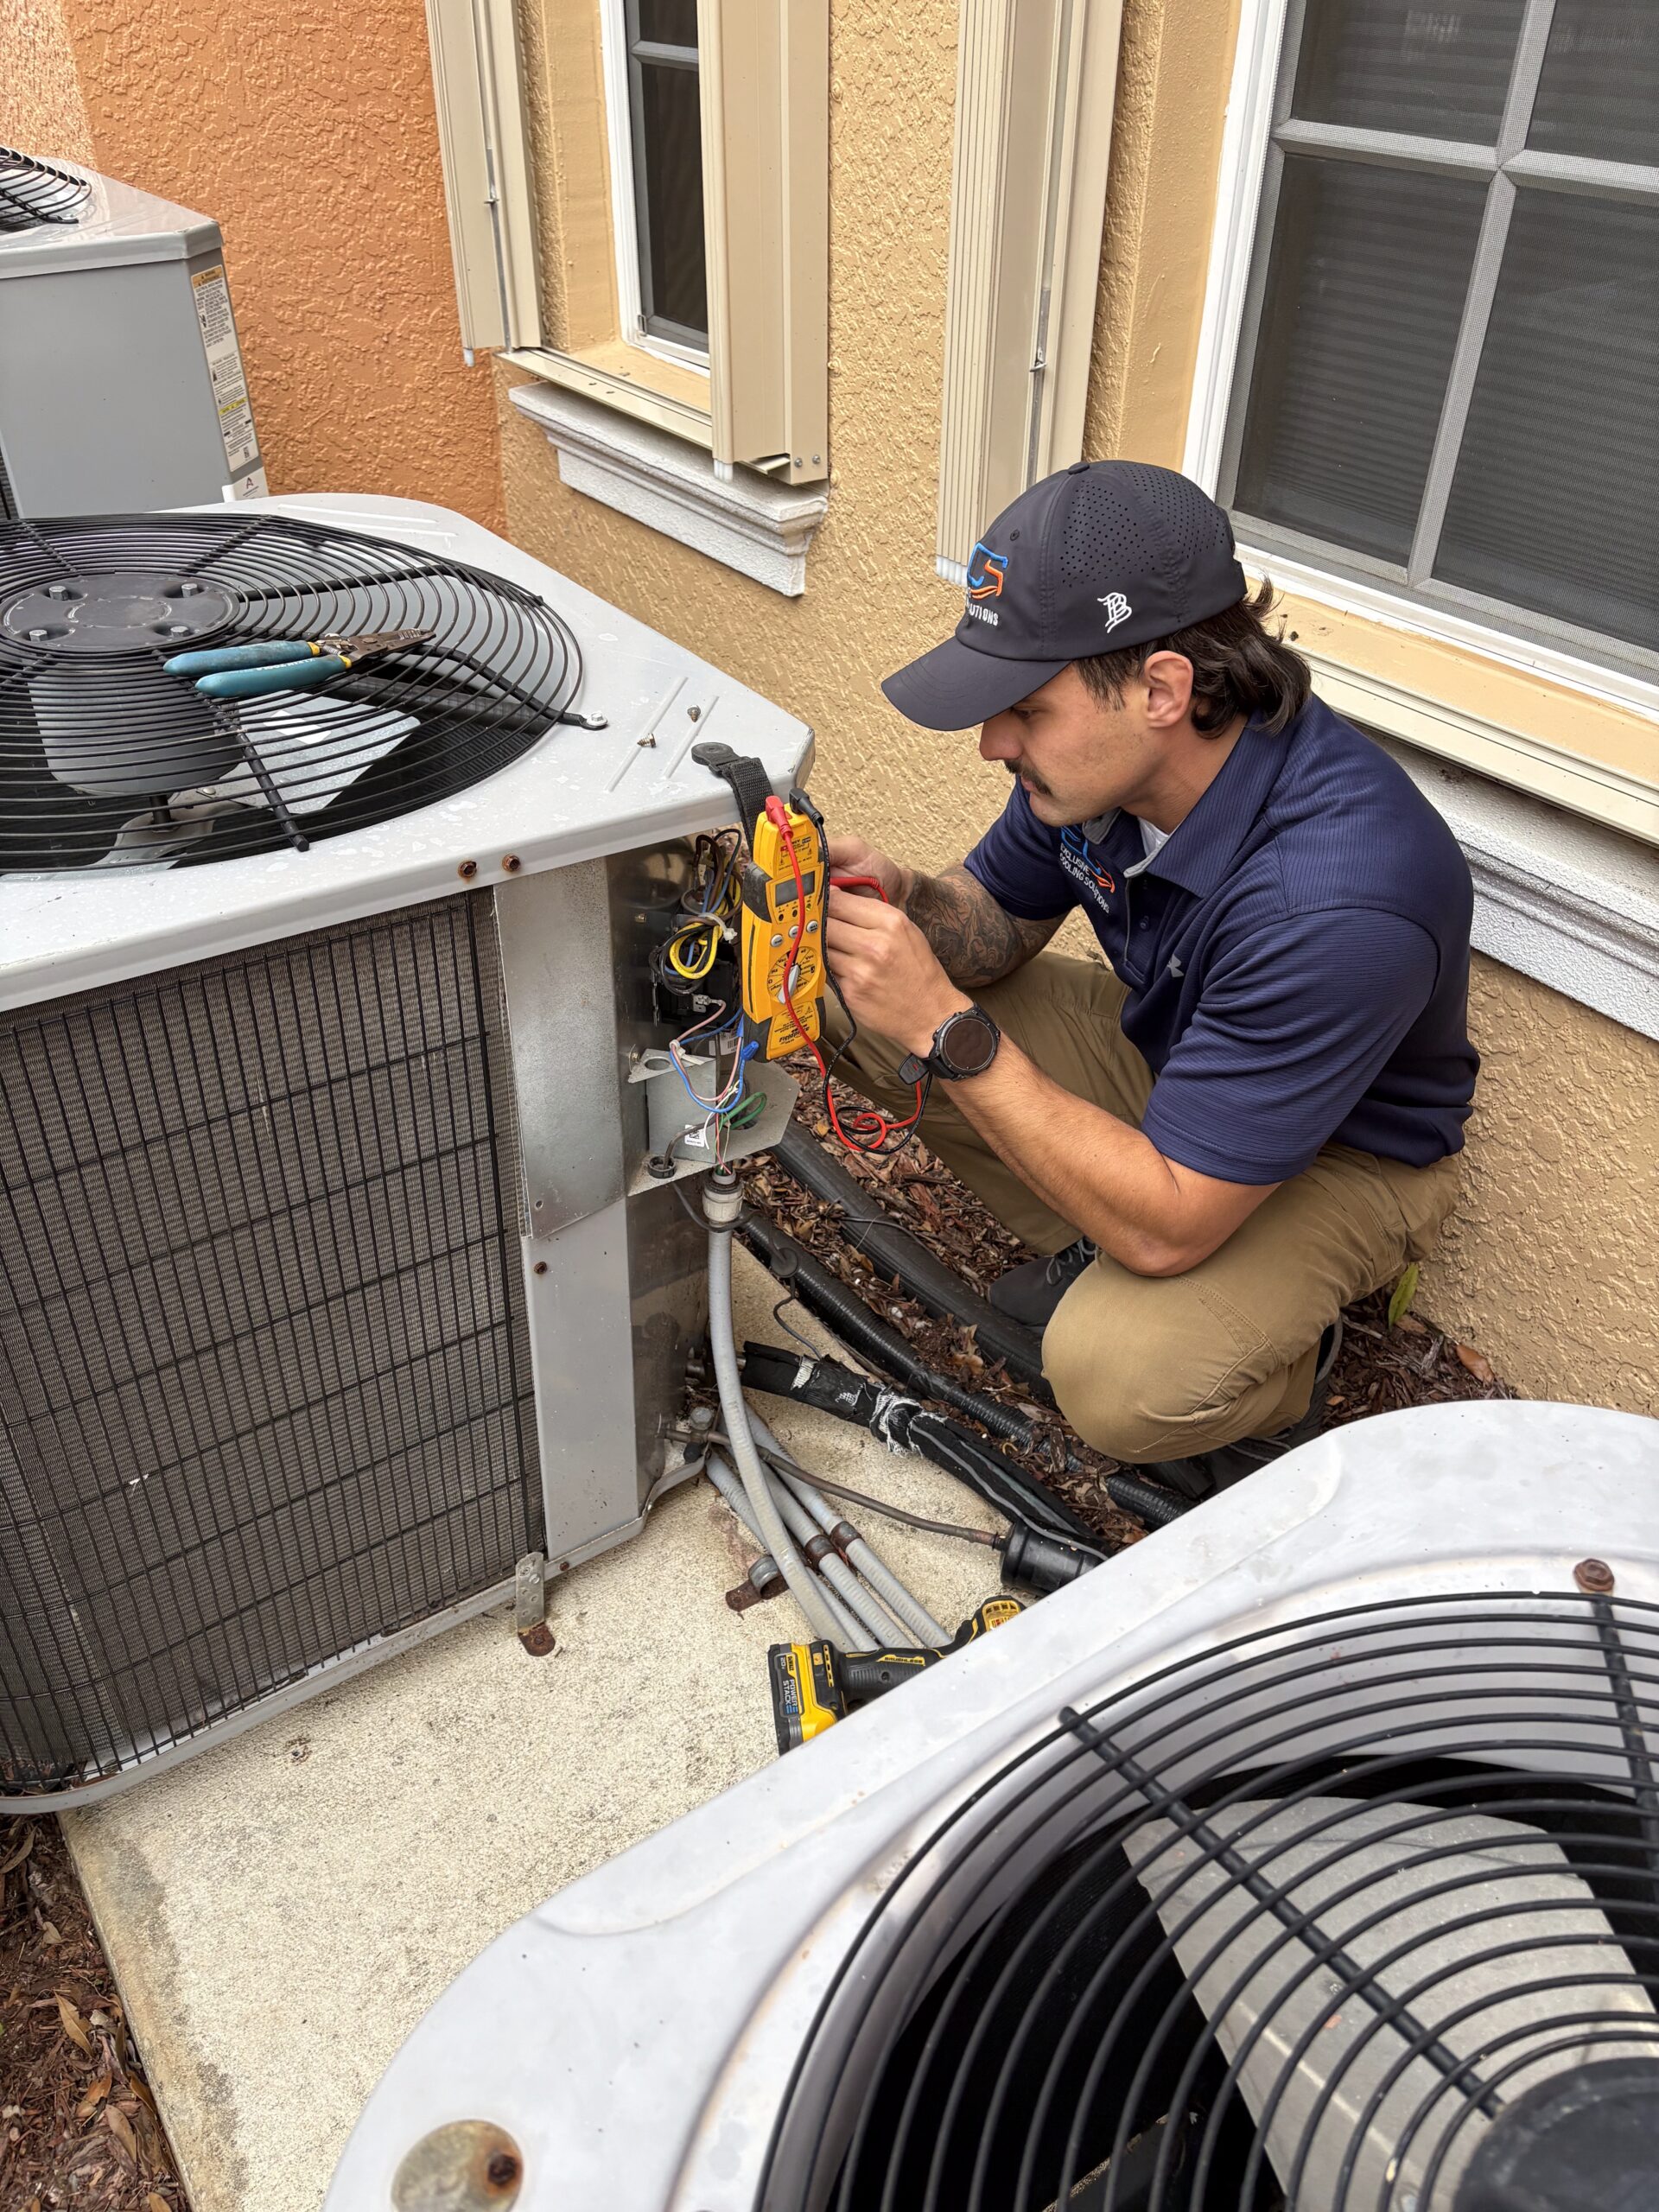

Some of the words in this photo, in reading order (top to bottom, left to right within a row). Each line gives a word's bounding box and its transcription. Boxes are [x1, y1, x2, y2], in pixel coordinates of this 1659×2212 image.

[1060, 842, 1090, 876] EXCLUSIVE
[1084, 877, 1109, 913] SOLUTIONS
[782, 1679, 792, 1706] STACK
[789, 1679, 798, 1707] POWER
